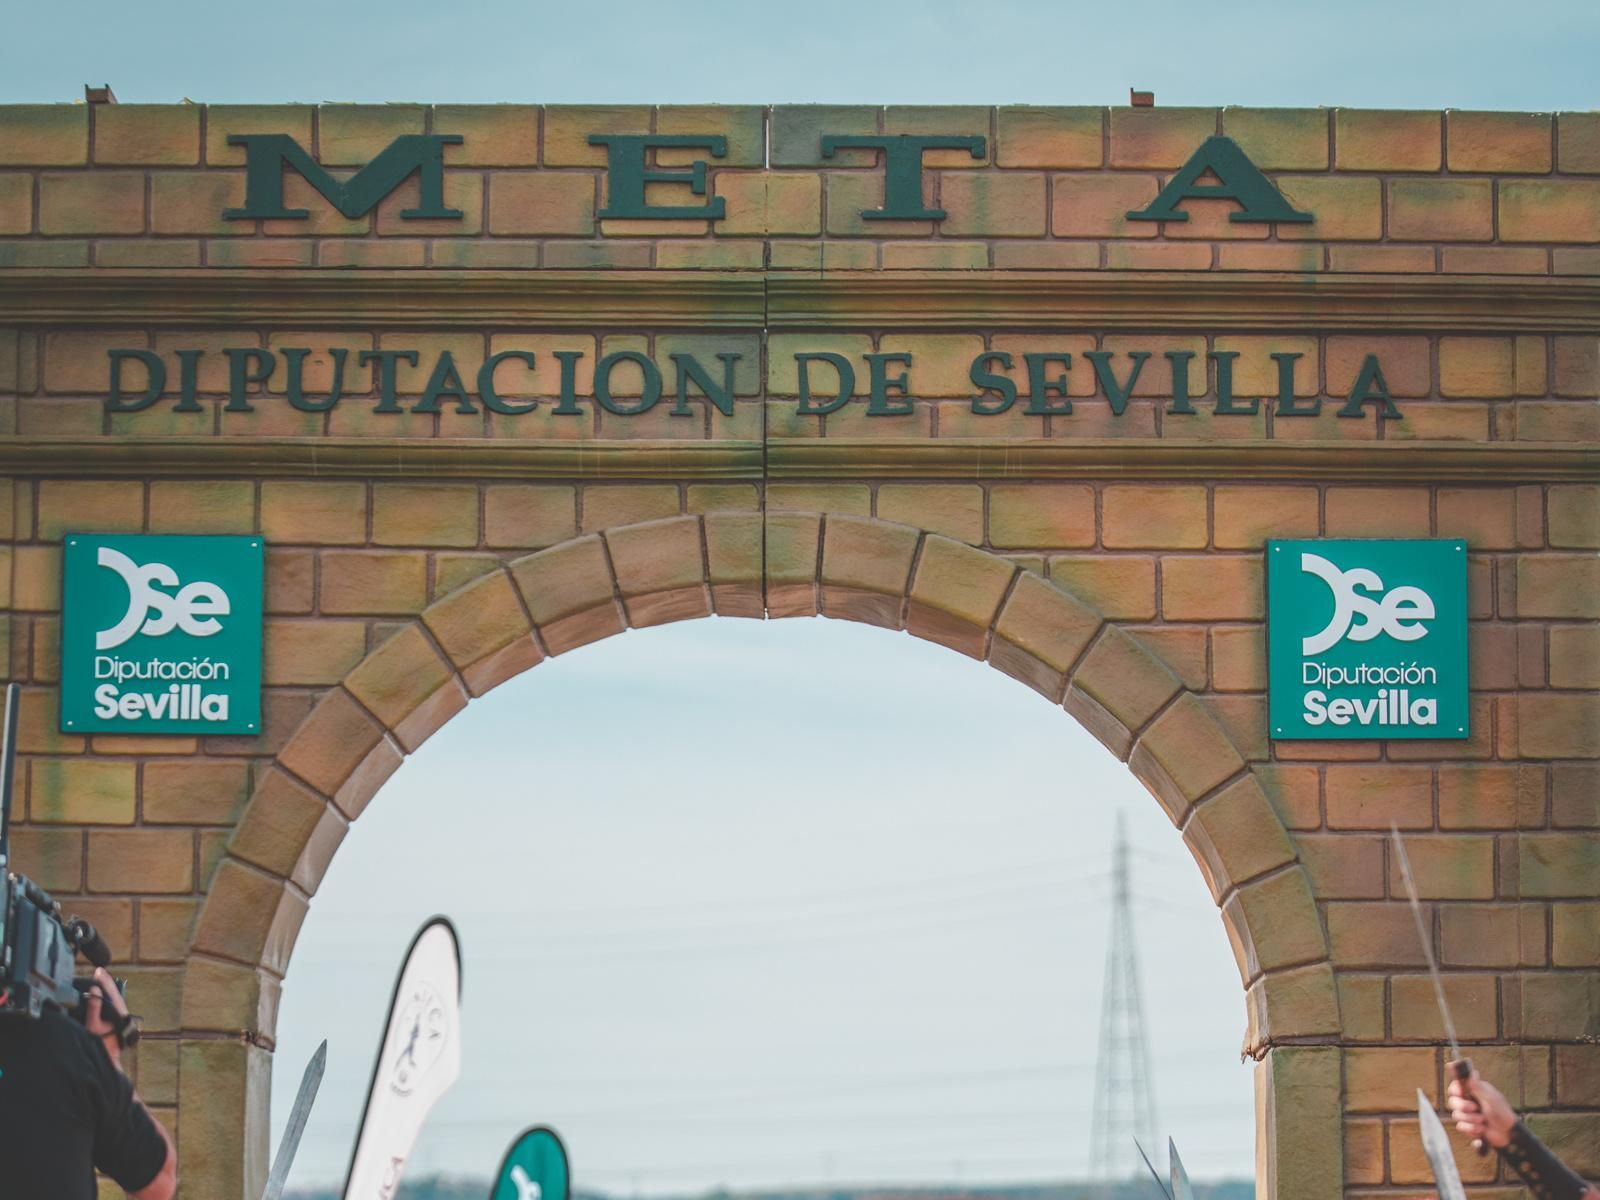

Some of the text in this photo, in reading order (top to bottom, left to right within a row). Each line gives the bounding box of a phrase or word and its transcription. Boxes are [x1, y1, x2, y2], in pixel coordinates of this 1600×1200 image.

[222, 132, 1314, 223] META
[105, 347, 1403, 420] DIPUTACION DE SEVILLA
[95, 656, 229, 685] Diputación
[1302, 661, 1436, 689] Diputación
[94, 684, 229, 722] Sevilla
[1302, 689, 1437, 727] Sevilla
